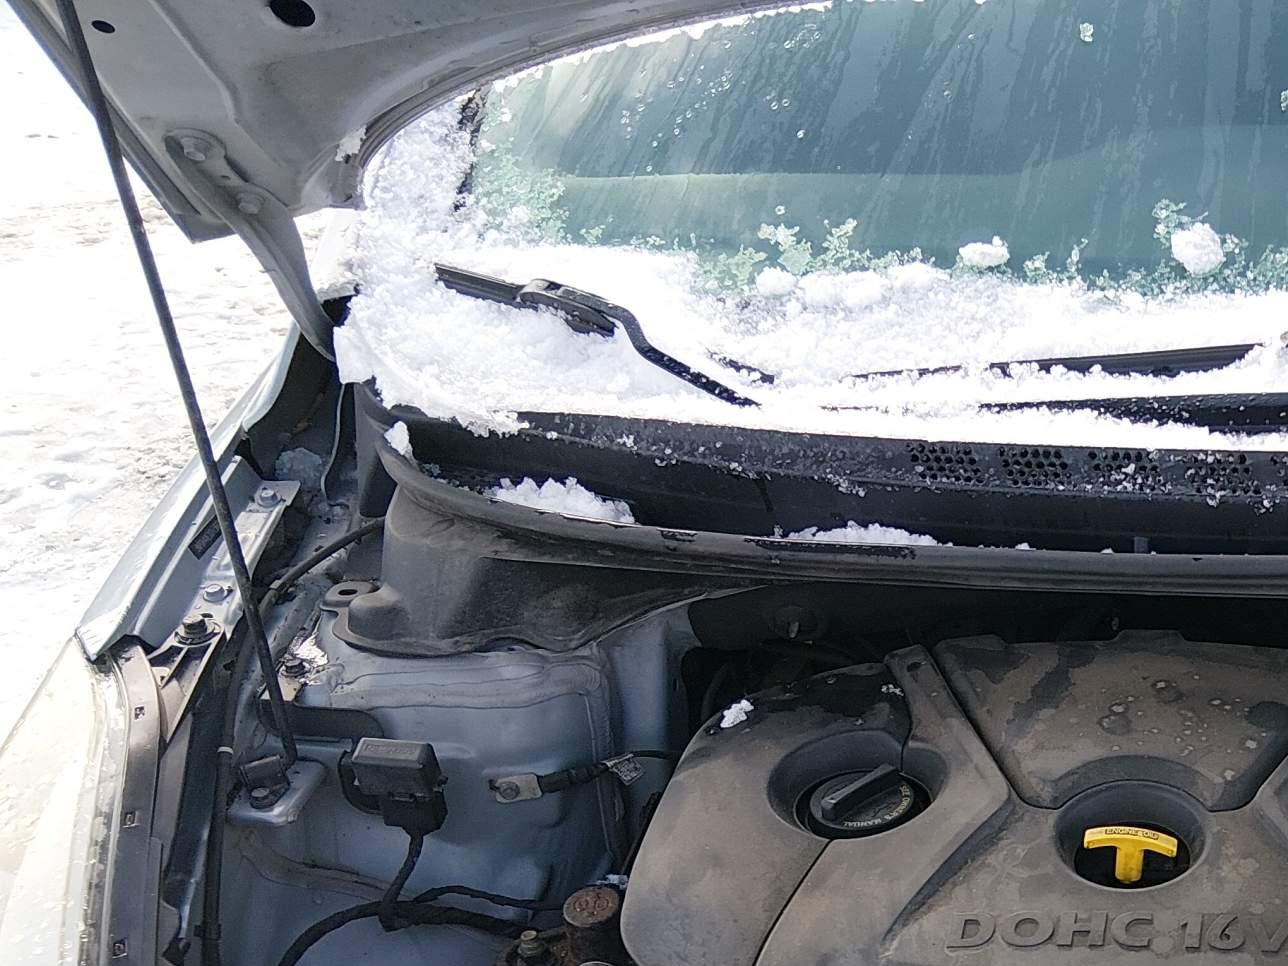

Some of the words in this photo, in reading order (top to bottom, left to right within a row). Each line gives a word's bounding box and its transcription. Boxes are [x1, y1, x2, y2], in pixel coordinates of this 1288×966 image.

[1105, 827, 1138, 837] ENGINE
[1142, 830, 1160, 841] OIL
[946, 910, 1154, 951] DOHC
